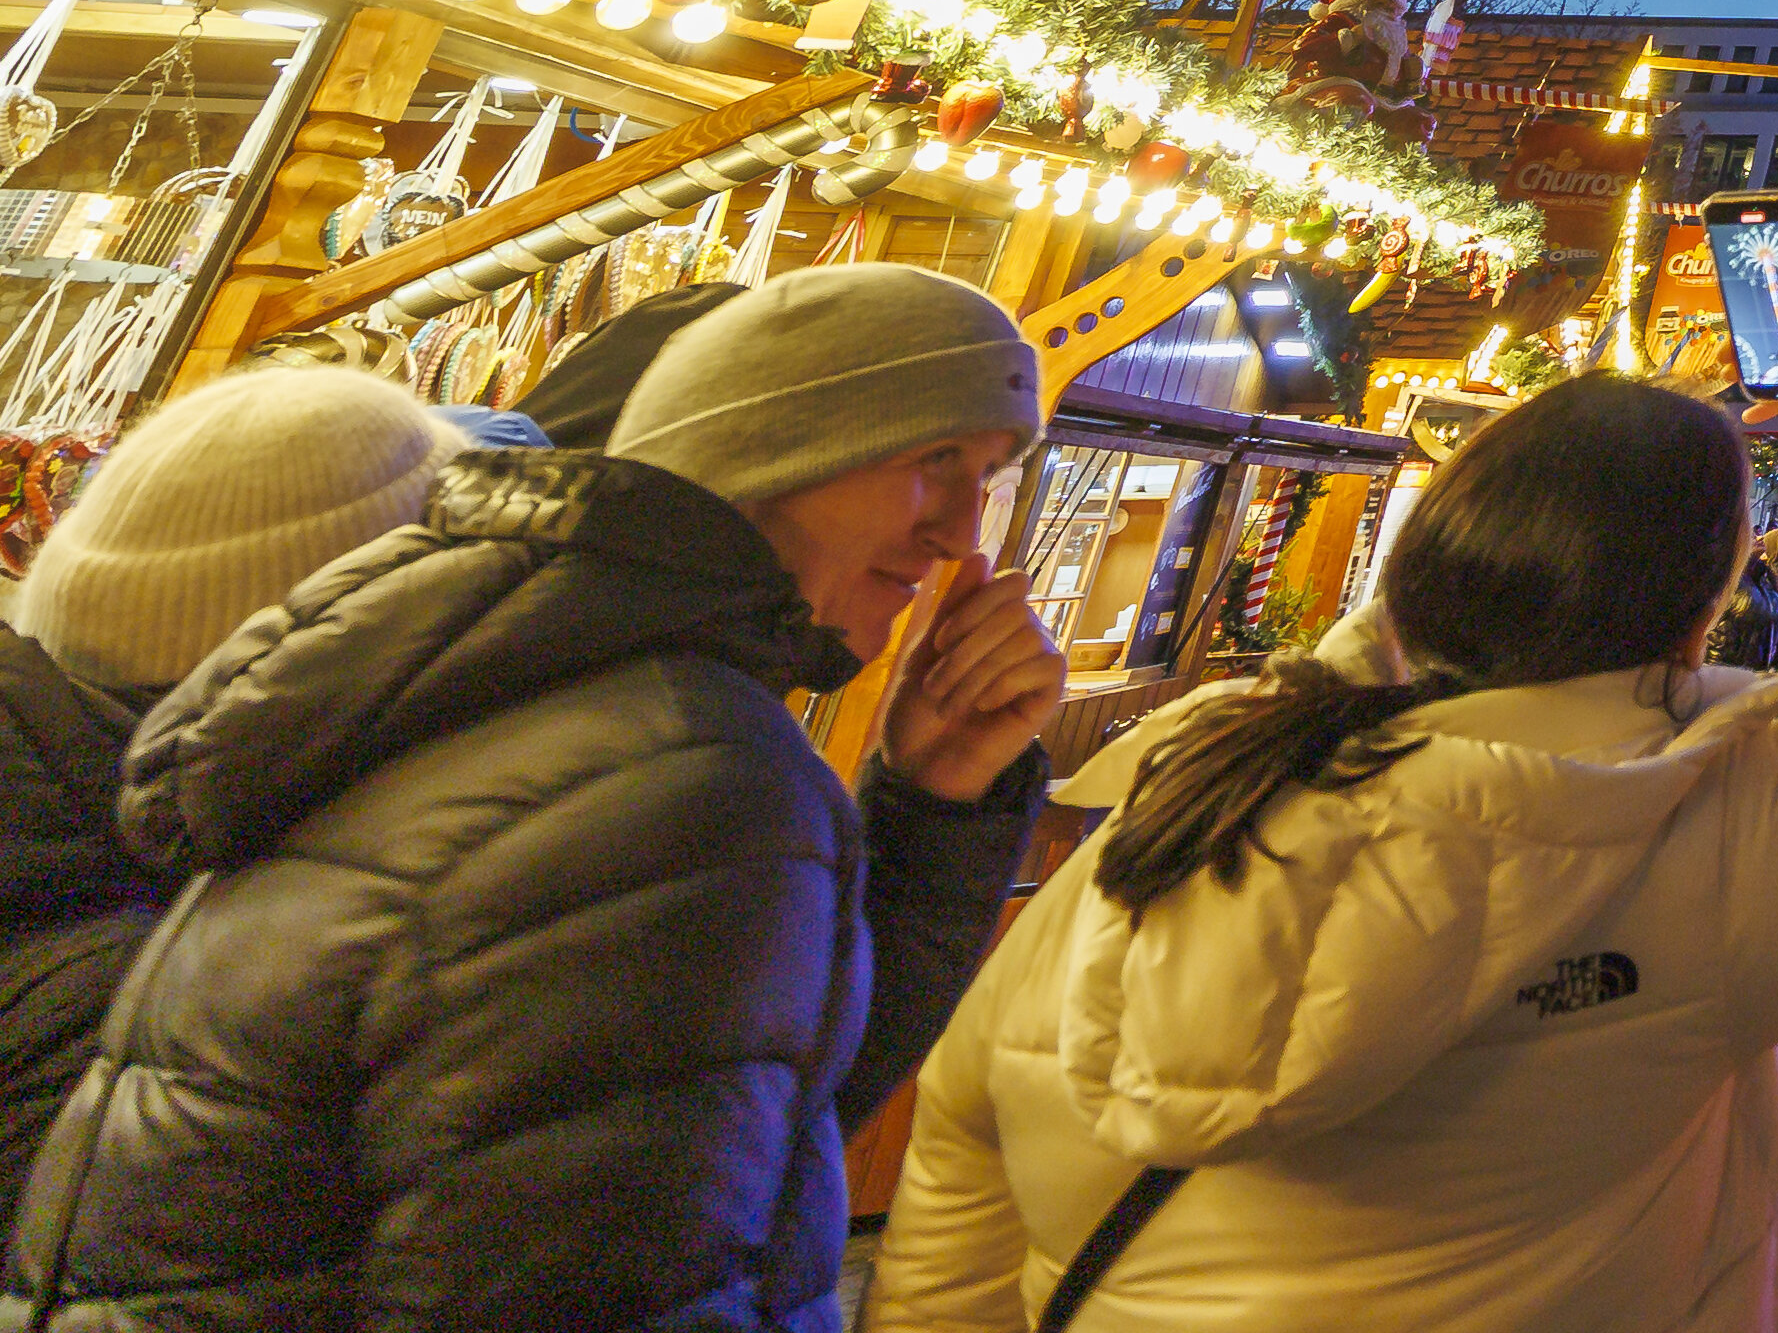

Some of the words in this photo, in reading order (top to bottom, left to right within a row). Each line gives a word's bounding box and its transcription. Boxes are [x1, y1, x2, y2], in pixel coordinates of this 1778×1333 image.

[1517, 162, 1627, 196] Churros
[400, 208, 448, 226] NEIN
[1548, 248, 1600, 262] OREO
[1667, 253, 1716, 276] Chur
